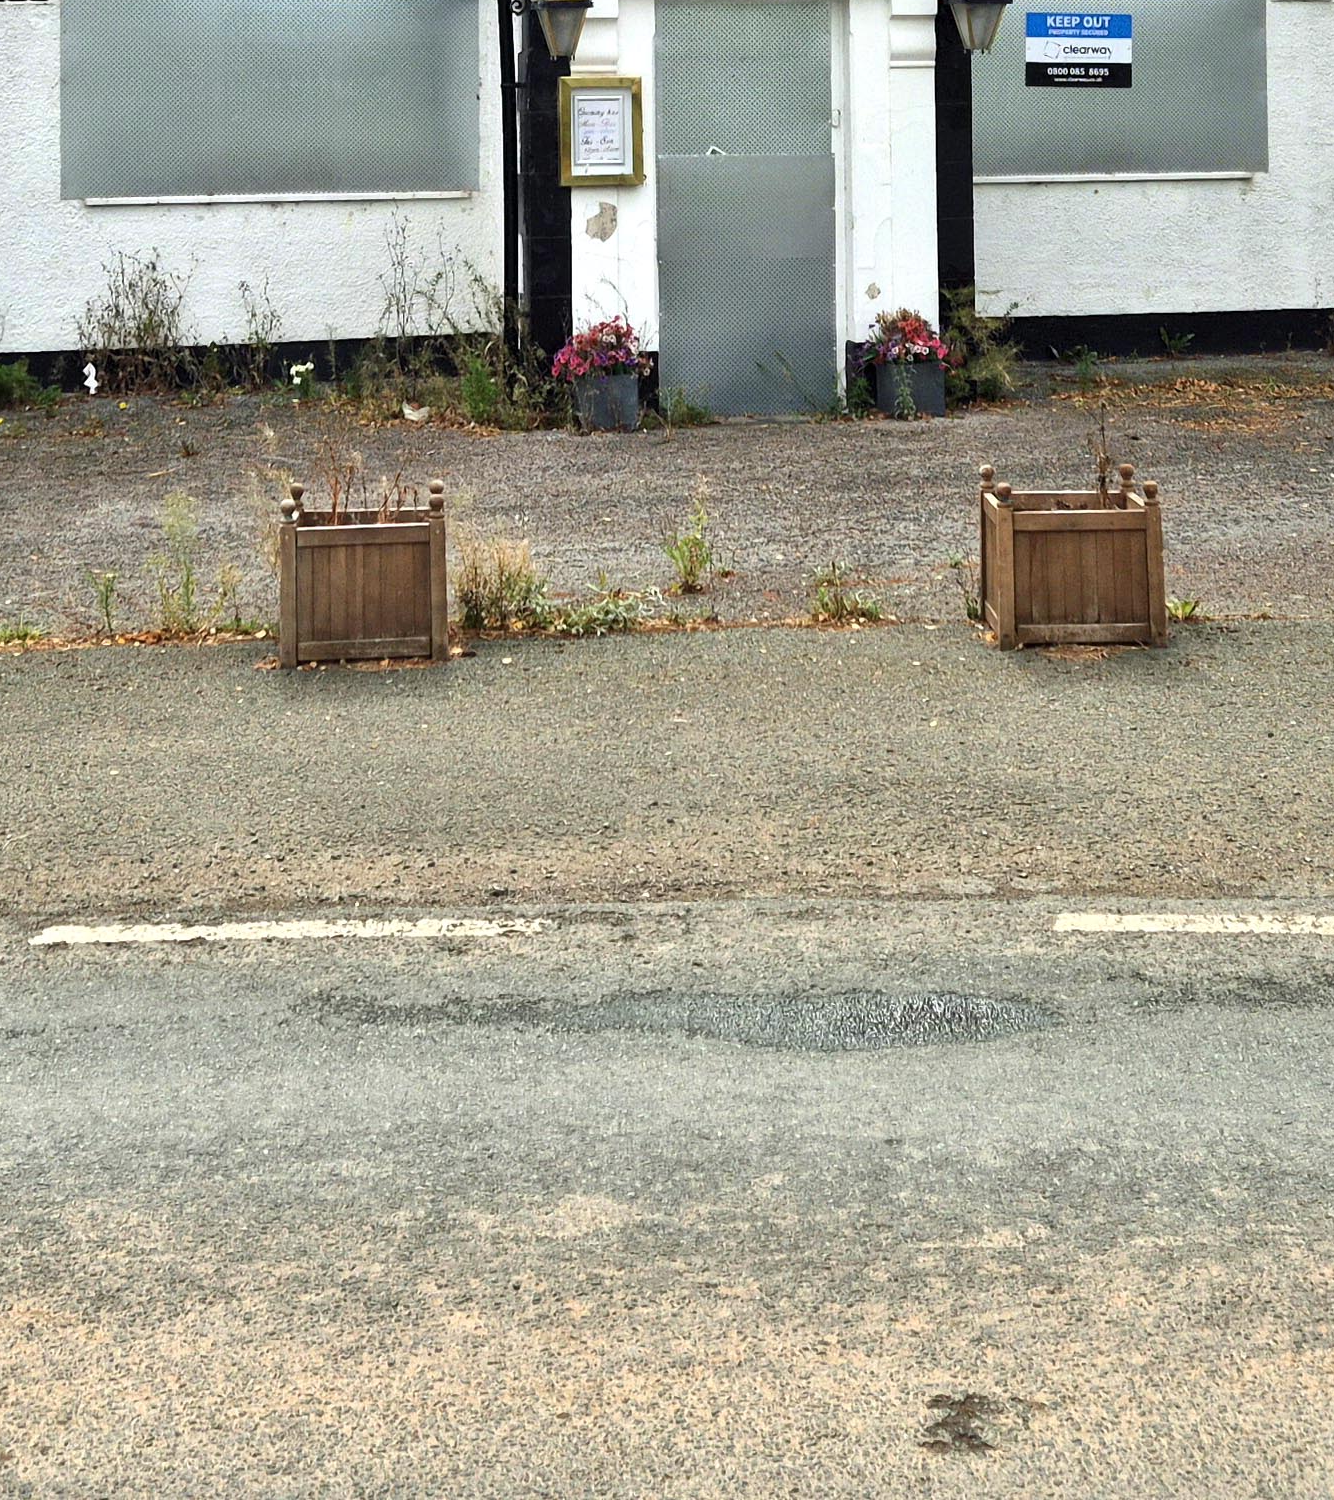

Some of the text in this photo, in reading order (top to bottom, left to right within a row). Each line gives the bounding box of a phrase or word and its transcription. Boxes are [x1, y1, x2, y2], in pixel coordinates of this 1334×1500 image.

[1046, 16, 1111, 28] KEEP OUT
[1062, 45, 1113, 60] clearway
